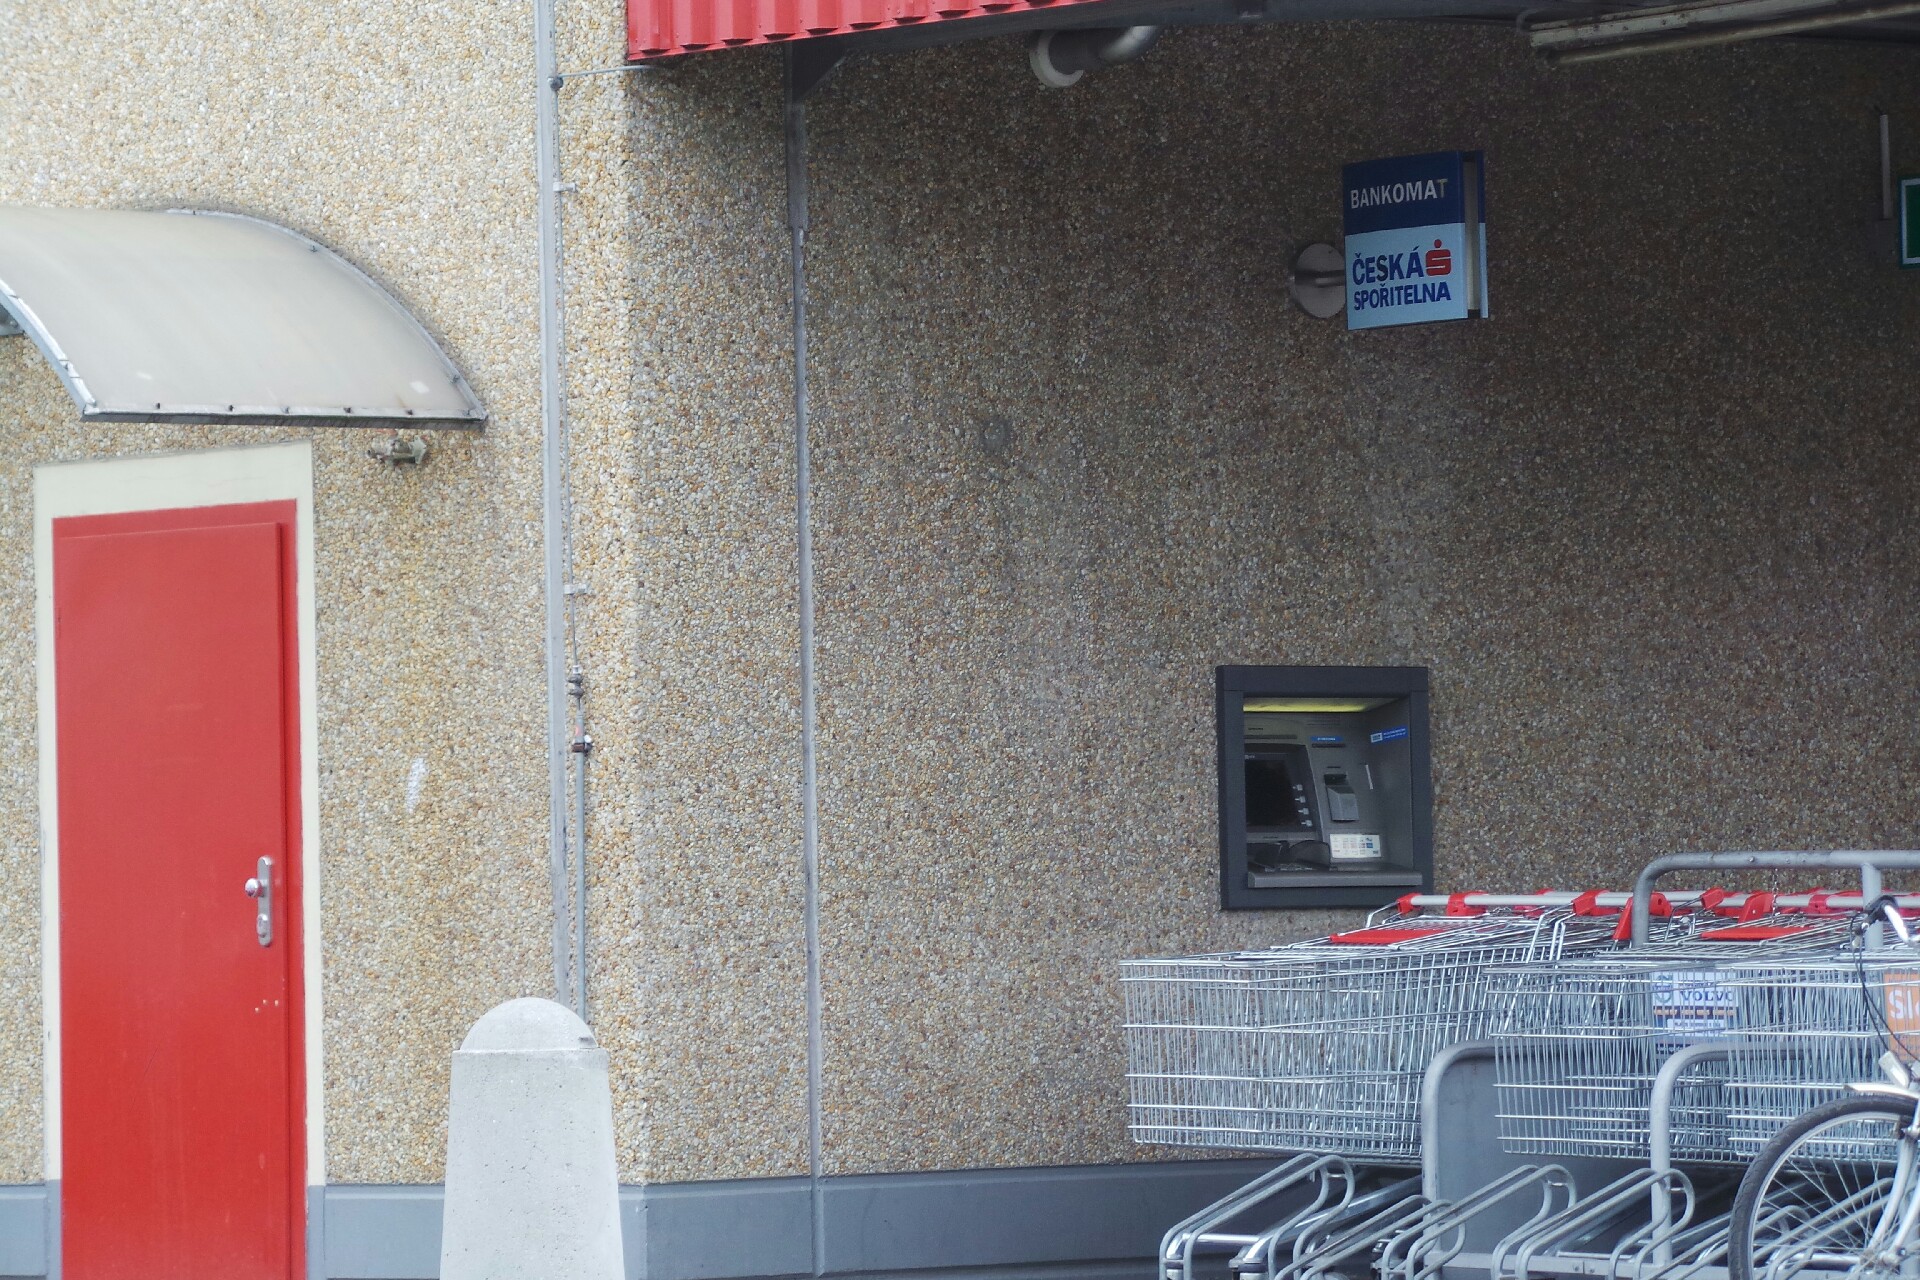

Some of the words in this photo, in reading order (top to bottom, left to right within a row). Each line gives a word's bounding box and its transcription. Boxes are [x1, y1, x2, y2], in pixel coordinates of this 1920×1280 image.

[1350, 178, 1448, 209] BANKOMAT
[1352, 246, 1424, 286] ČESKÁ
[1353, 281, 1451, 311] SPOŘITELNA
